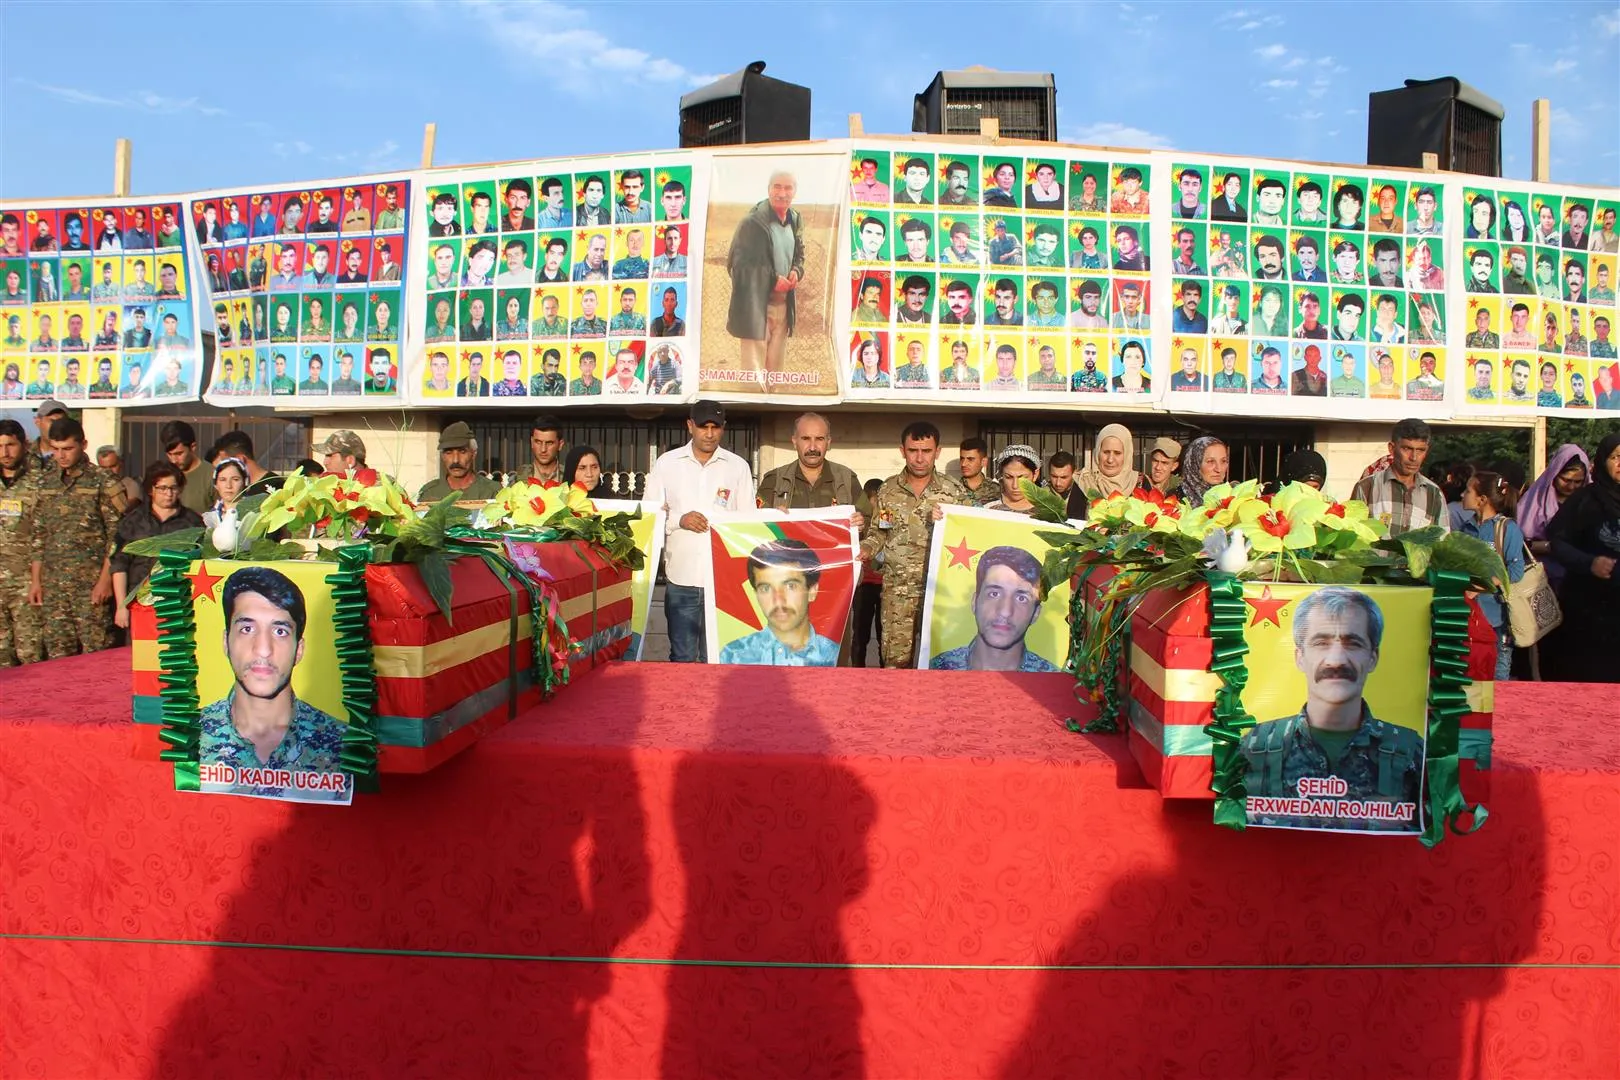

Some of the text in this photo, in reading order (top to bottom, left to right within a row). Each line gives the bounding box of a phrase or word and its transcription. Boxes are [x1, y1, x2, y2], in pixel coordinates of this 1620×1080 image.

[1280, 609, 1289, 617] G
[240, 768, 291, 787] KADIR
[295, 773, 344, 790] UCAR
[1298, 777, 1346, 796] ŞEHÎD
[1338, 802, 1415, 818] ROJHILAT
